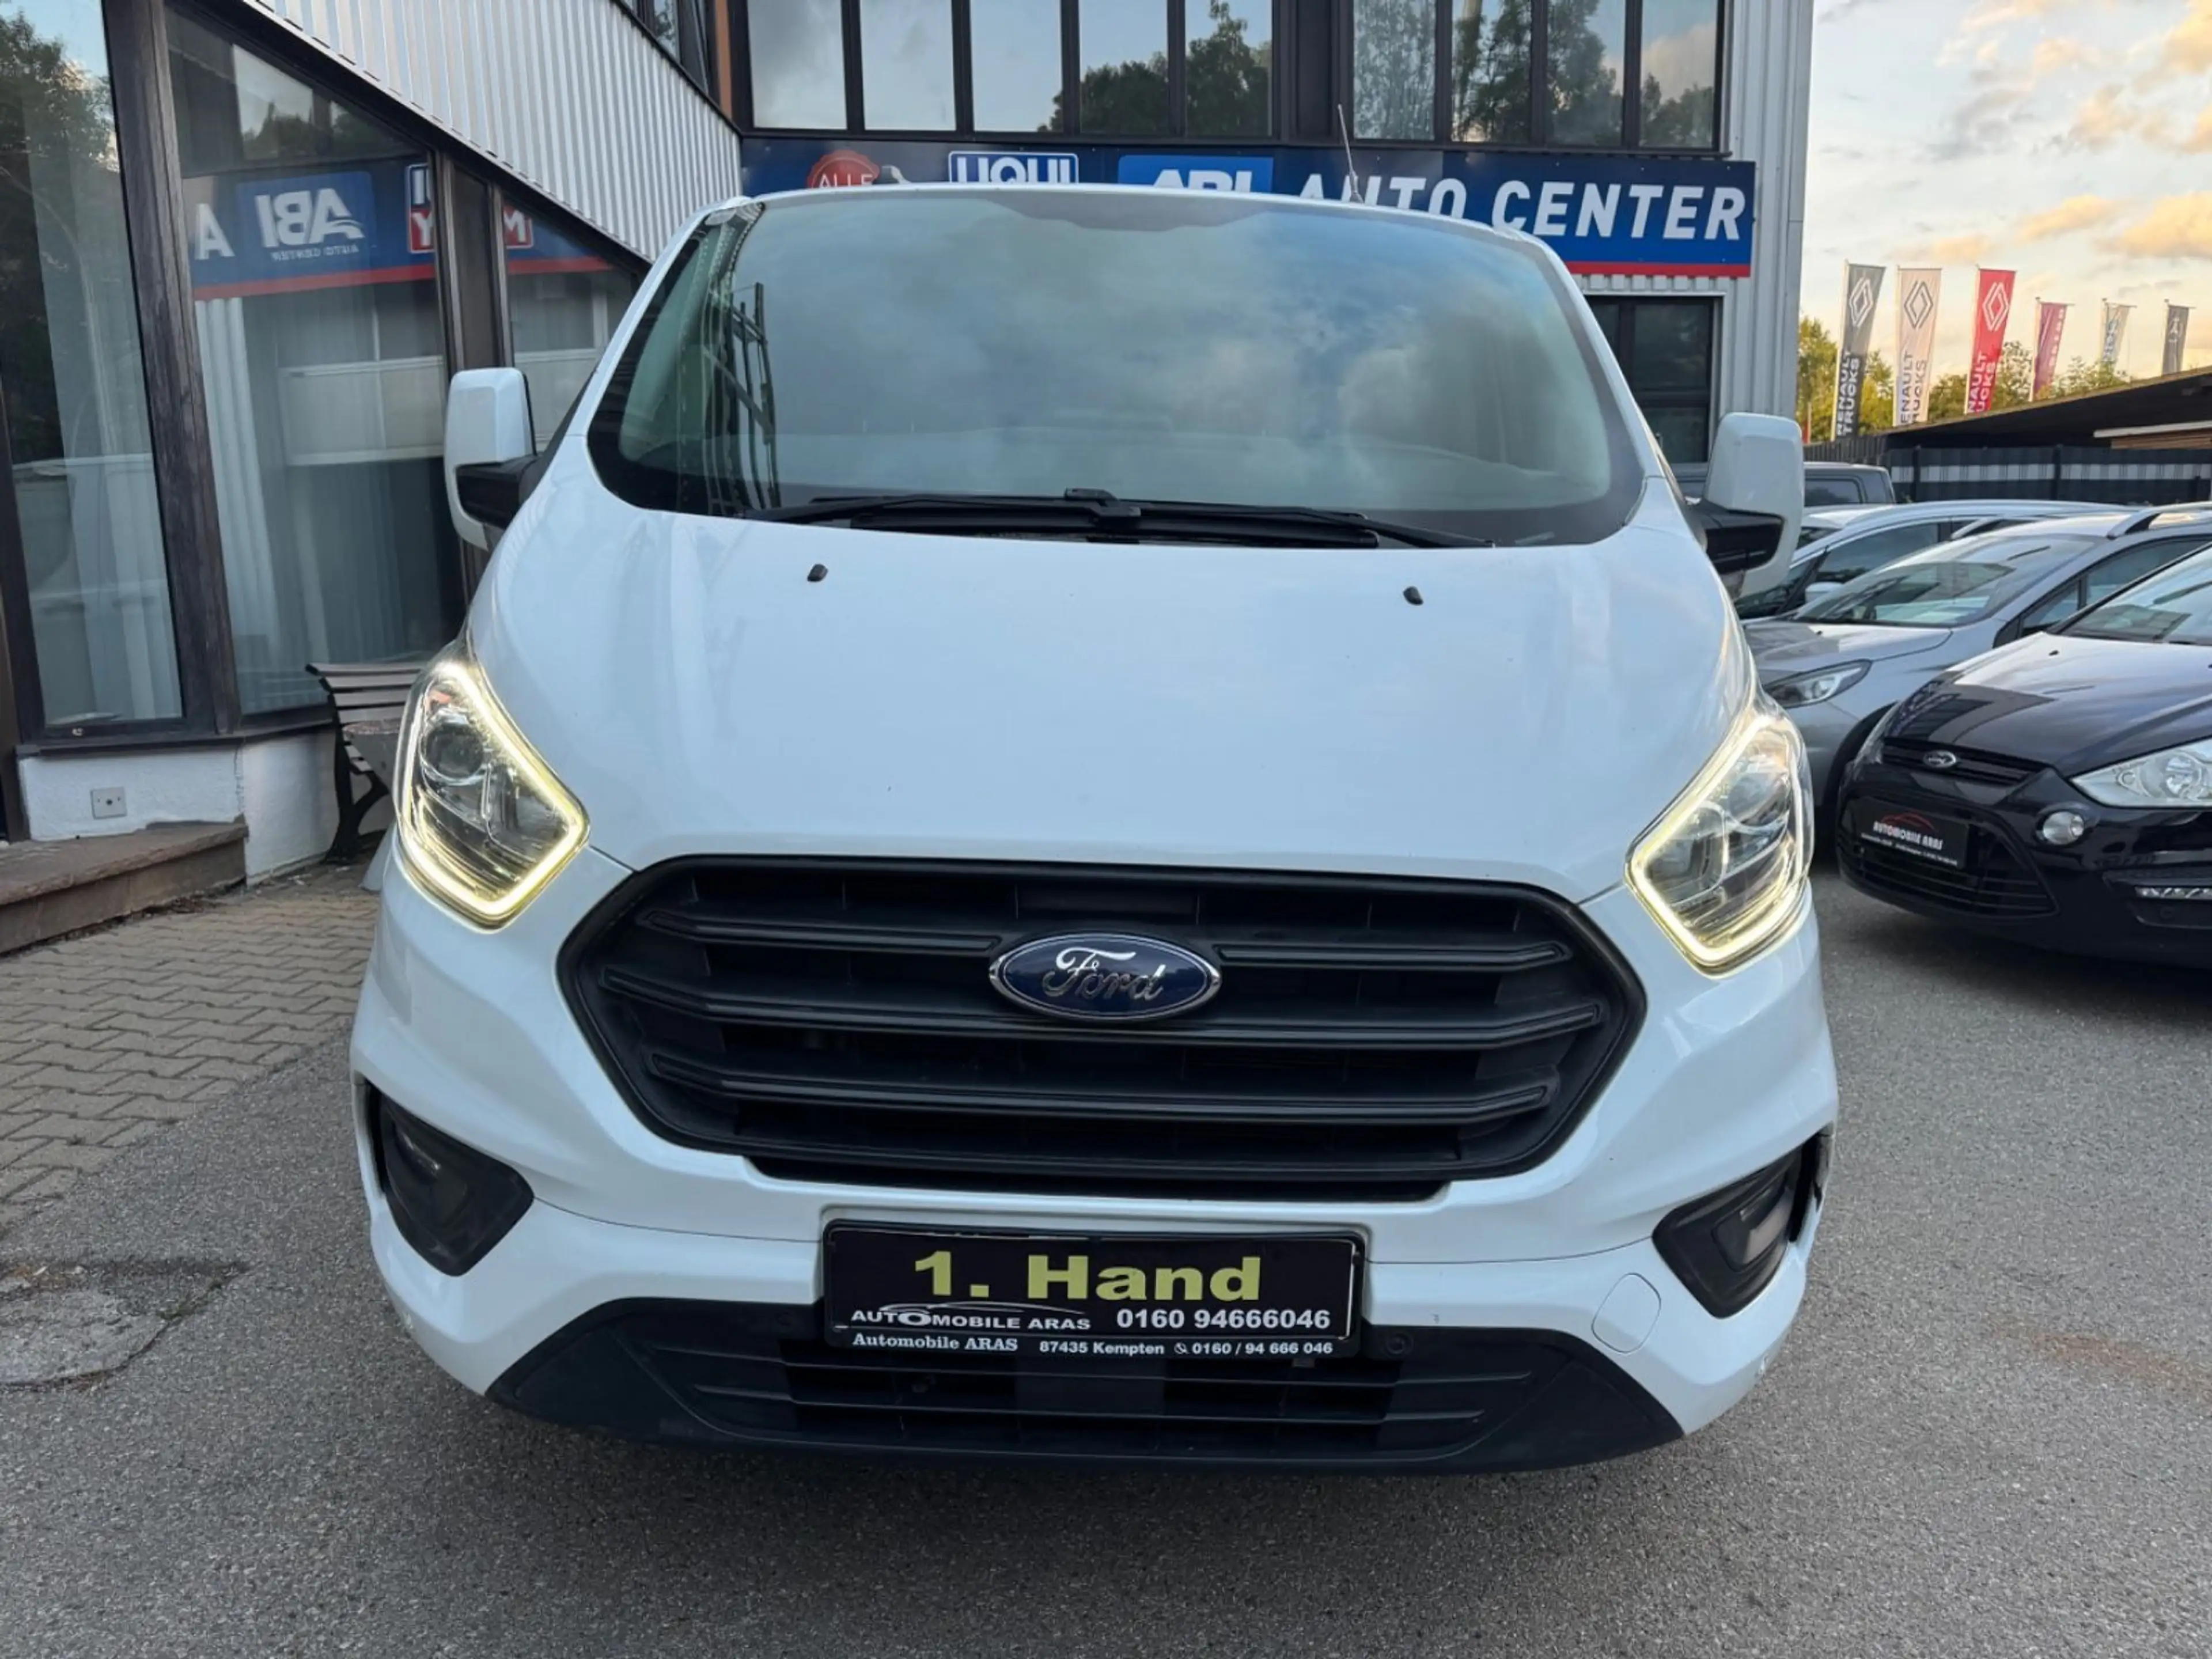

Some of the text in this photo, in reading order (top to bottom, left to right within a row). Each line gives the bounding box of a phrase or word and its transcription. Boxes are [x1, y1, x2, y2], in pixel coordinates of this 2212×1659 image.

[1491, 180, 1746, 240] CENTER
[1843, 357, 1861, 435] TRUCKS
[1902, 350, 1913, 423] ENAULT
[1912, 359, 1927, 422] UCKS
[1968, 350, 1987, 413] NAULT
[1976, 361, 1996, 413] UCKS
[1041, 946, 1166, 1001] Ford
[915, 1250, 1261, 1302] 1. Hand
[851, 1310, 1091, 1330] AUTOMOBILE ARAS
[852, 1333, 960, 1350] Automobile
[964, 1338, 1018, 1351] ARAS
[1039, 1340, 1089, 1354] 87435
[1093, 1342, 1165, 1355] Kempten
[1192, 1343, 1232, 1354] 0160
[1244, 1343, 1265, 1354] 94
[1269, 1343, 1299, 1354] 666
[1303, 1343, 1334, 1354] 046
[1116, 1309, 1331, 1329] 0160 94666046
